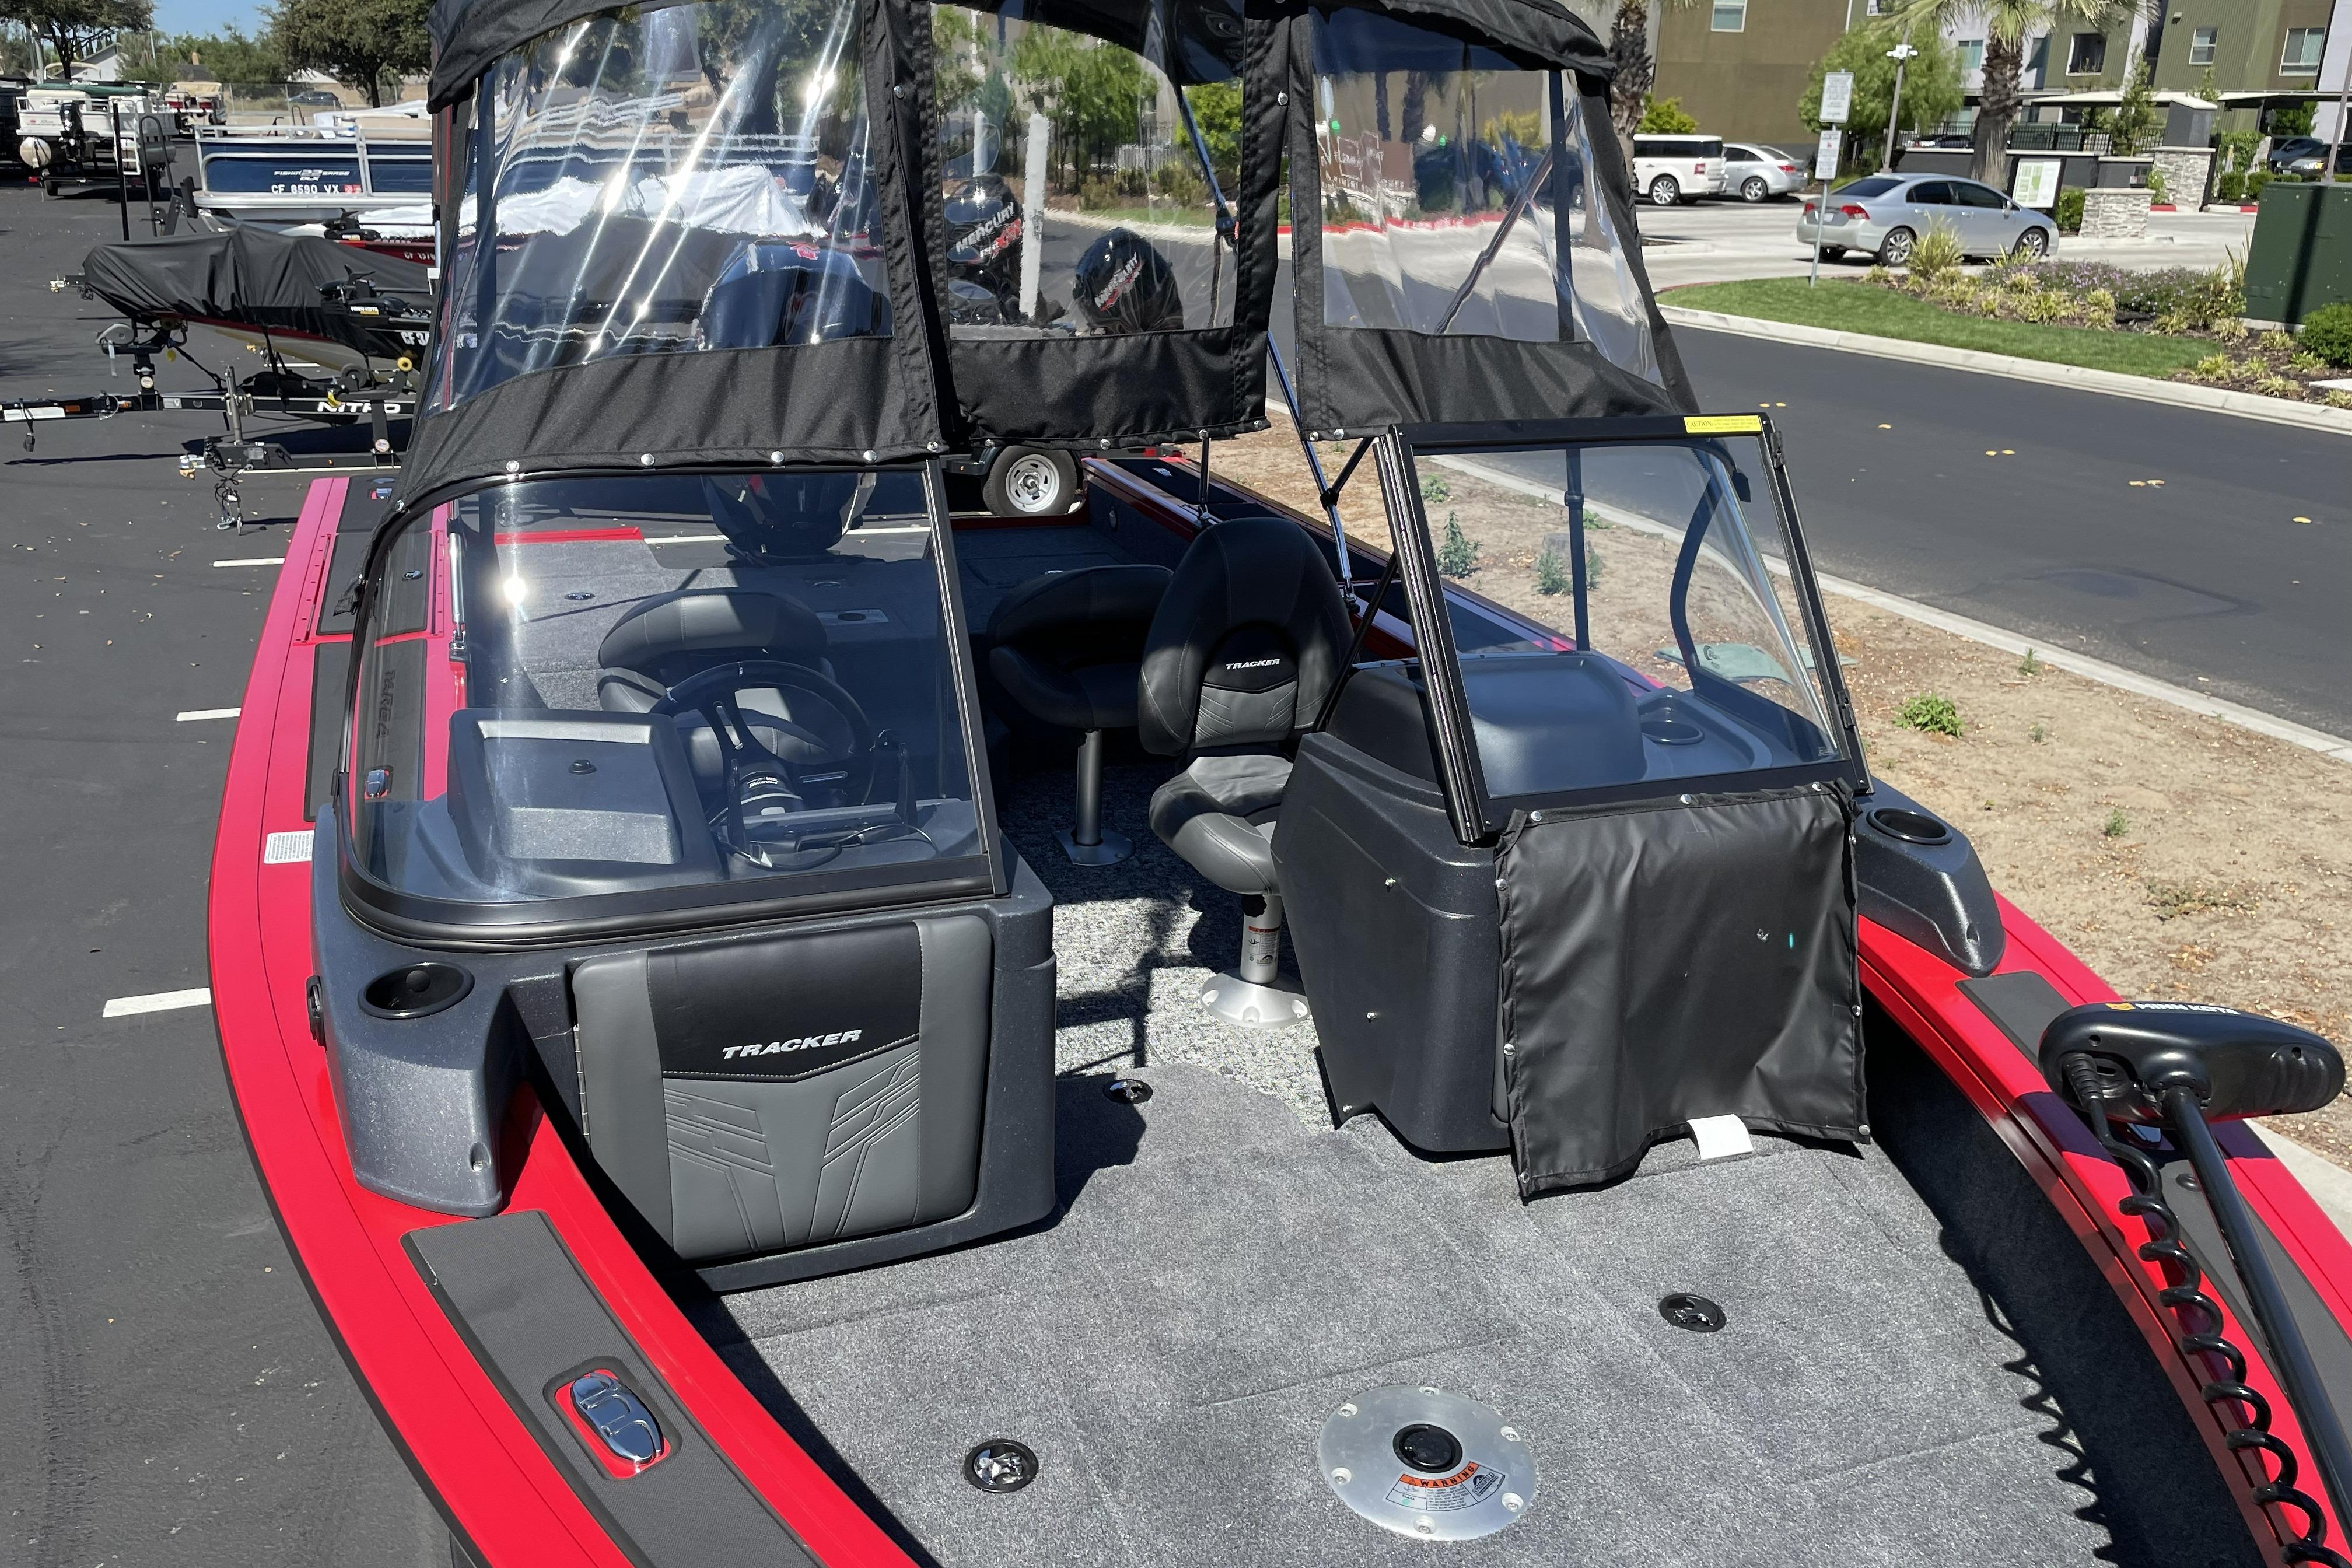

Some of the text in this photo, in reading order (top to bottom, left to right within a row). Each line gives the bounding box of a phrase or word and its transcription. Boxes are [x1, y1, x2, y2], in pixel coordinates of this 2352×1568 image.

[271, 184, 285, 194] CF
[290, 184, 318, 194] 8590
[324, 184, 340, 194] VX
[956, 201, 1014, 254] MERCURY
[401, 331, 415, 345] CF
[1226, 659, 1280, 670] TRACKER
[2188, 1005, 2241, 1015] KOTA
[722, 1029, 862, 1060] TRACKER
[1420, 1466, 1475, 1486] WARNING
